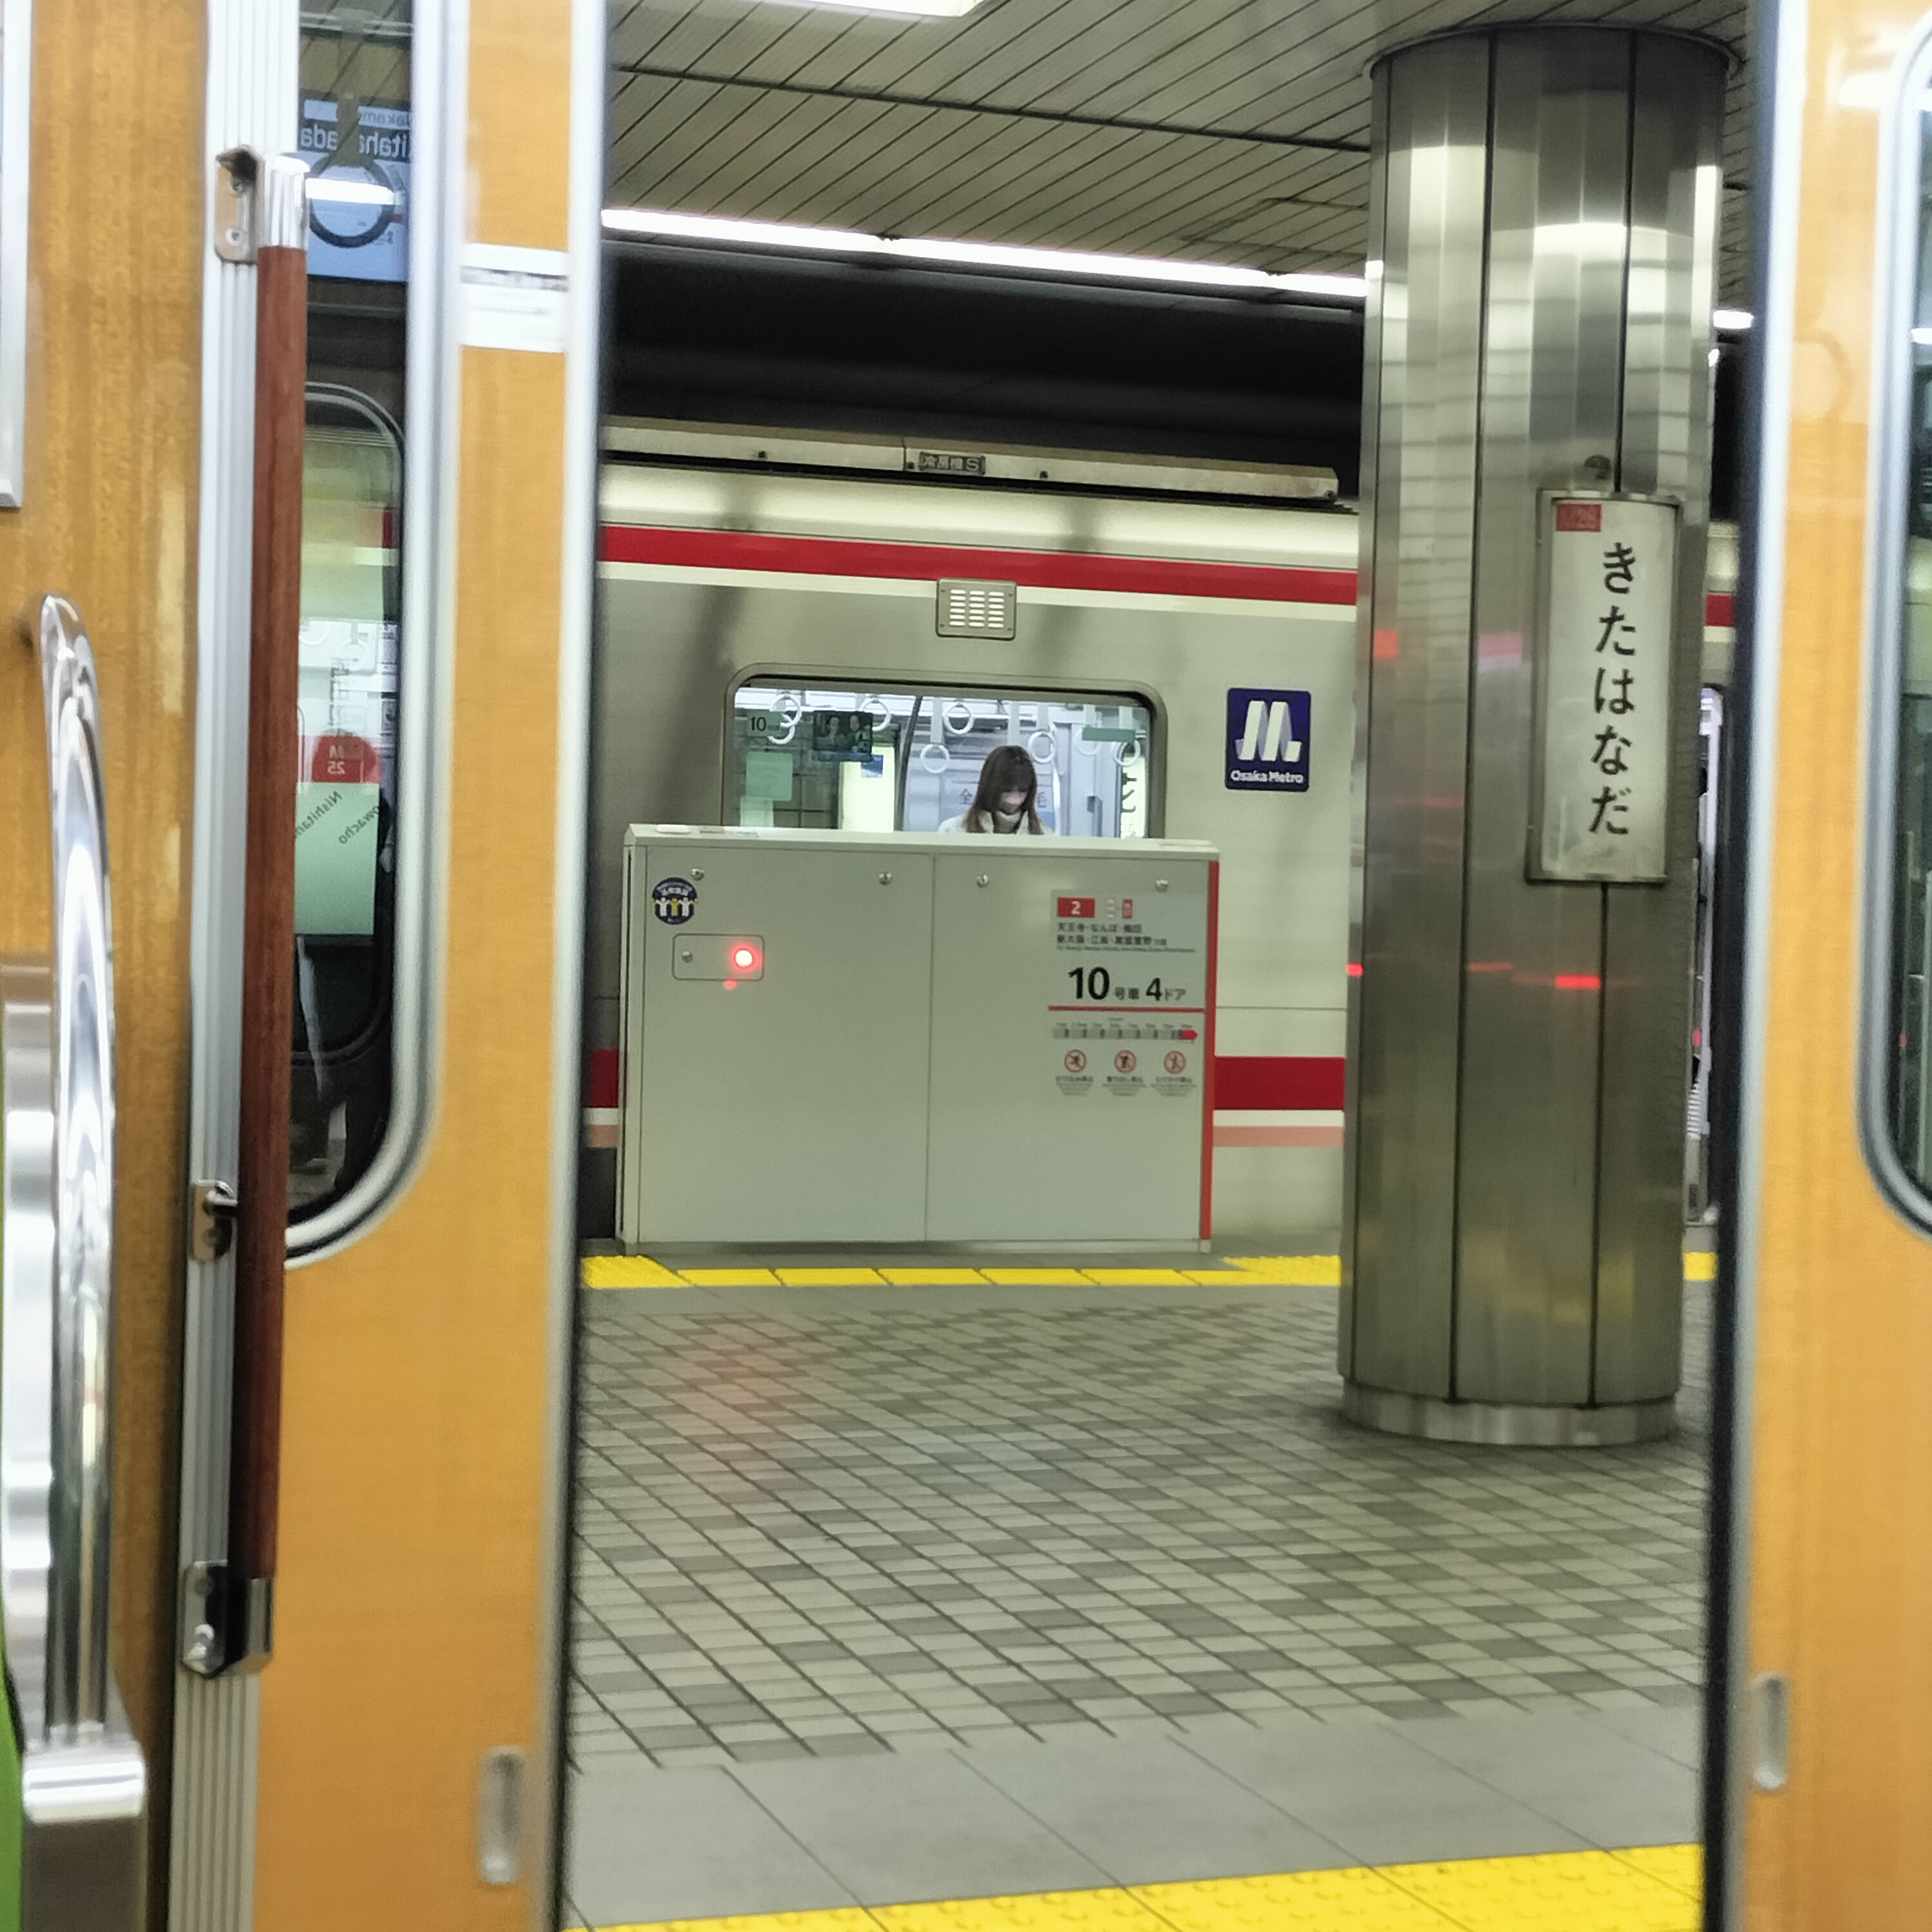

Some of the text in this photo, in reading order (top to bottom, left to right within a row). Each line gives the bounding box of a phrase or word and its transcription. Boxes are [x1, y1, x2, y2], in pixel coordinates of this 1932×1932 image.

[1587, 542, 1638, 835] きたはなだ
[1230, 770, 1303, 783] Osaka Metro
[1071, 900, 1081, 915] 2
